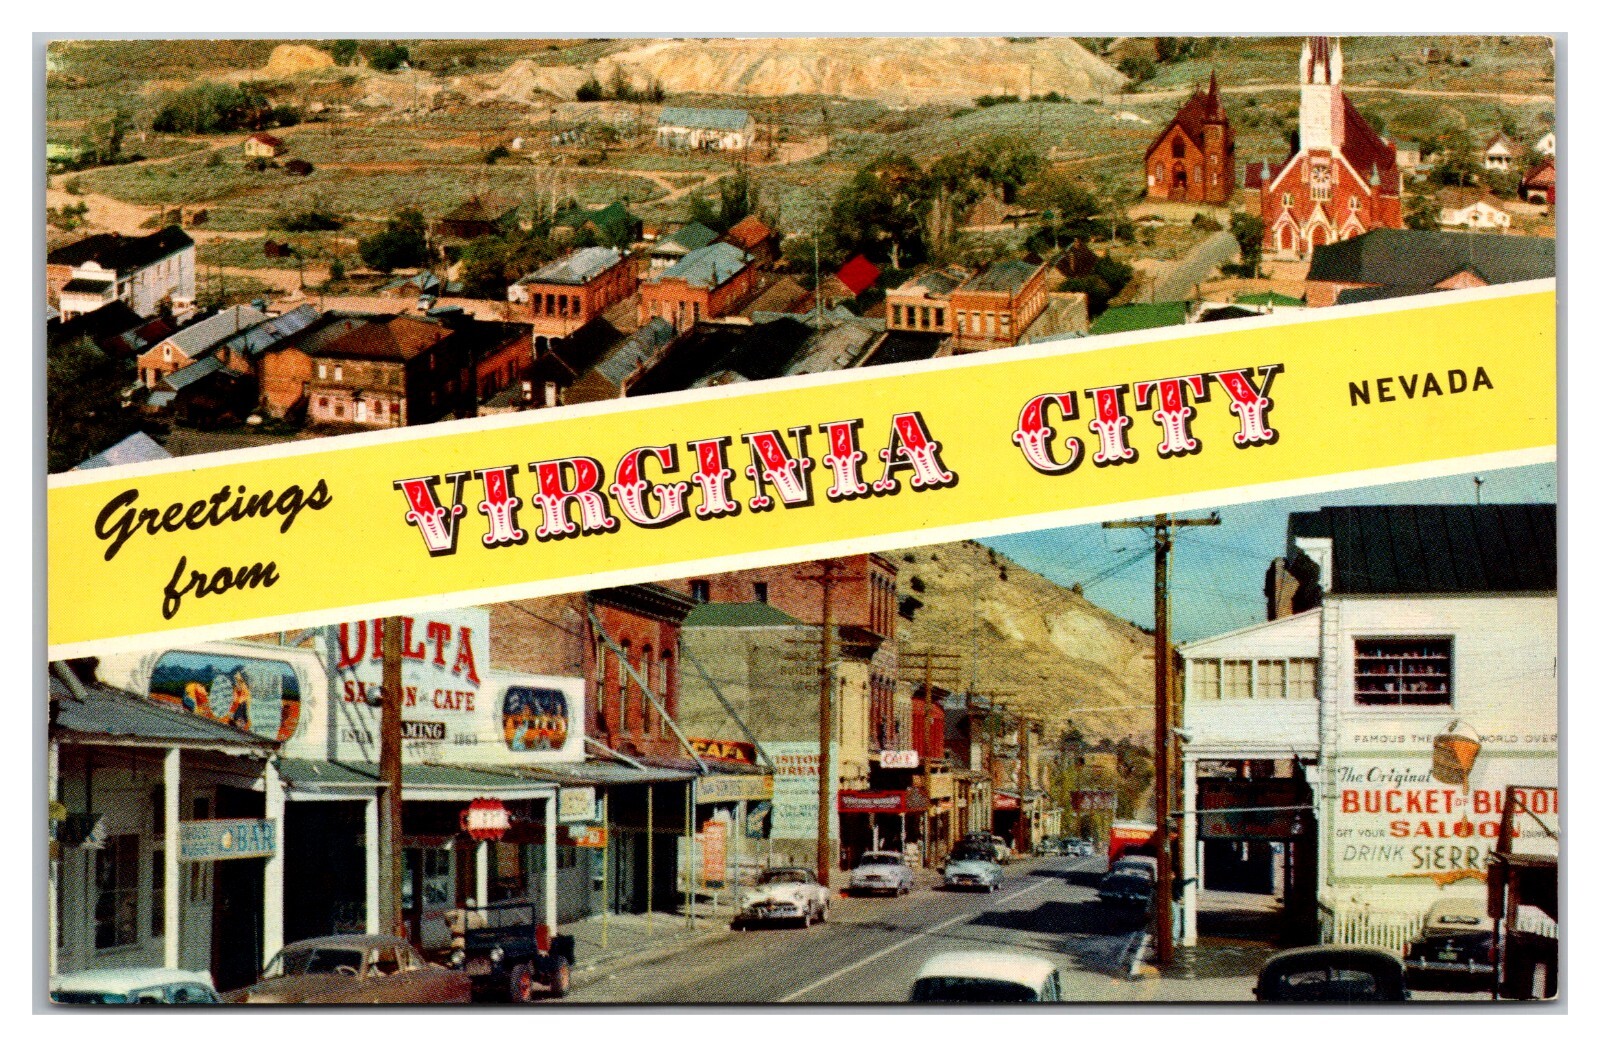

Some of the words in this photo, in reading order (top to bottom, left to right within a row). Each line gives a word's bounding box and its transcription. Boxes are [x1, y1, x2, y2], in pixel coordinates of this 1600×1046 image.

[433, 688, 475, 712] CAFE
[400, 722, 443, 738] AMING
[1354, 734, 1406, 743] FAMOUS
[1411, 734, 1433, 743] THE
[1336, 766, 1364, 783] The
[1367, 766, 1433, 788] Original
[1341, 789, 1455, 814] BUCKET
[237, 824, 277, 853] BAR
[1336, 828, 1352, 838] GET
[1358, 828, 1385, 838] YOUR
[1343, 845, 1404, 861] DRINK
